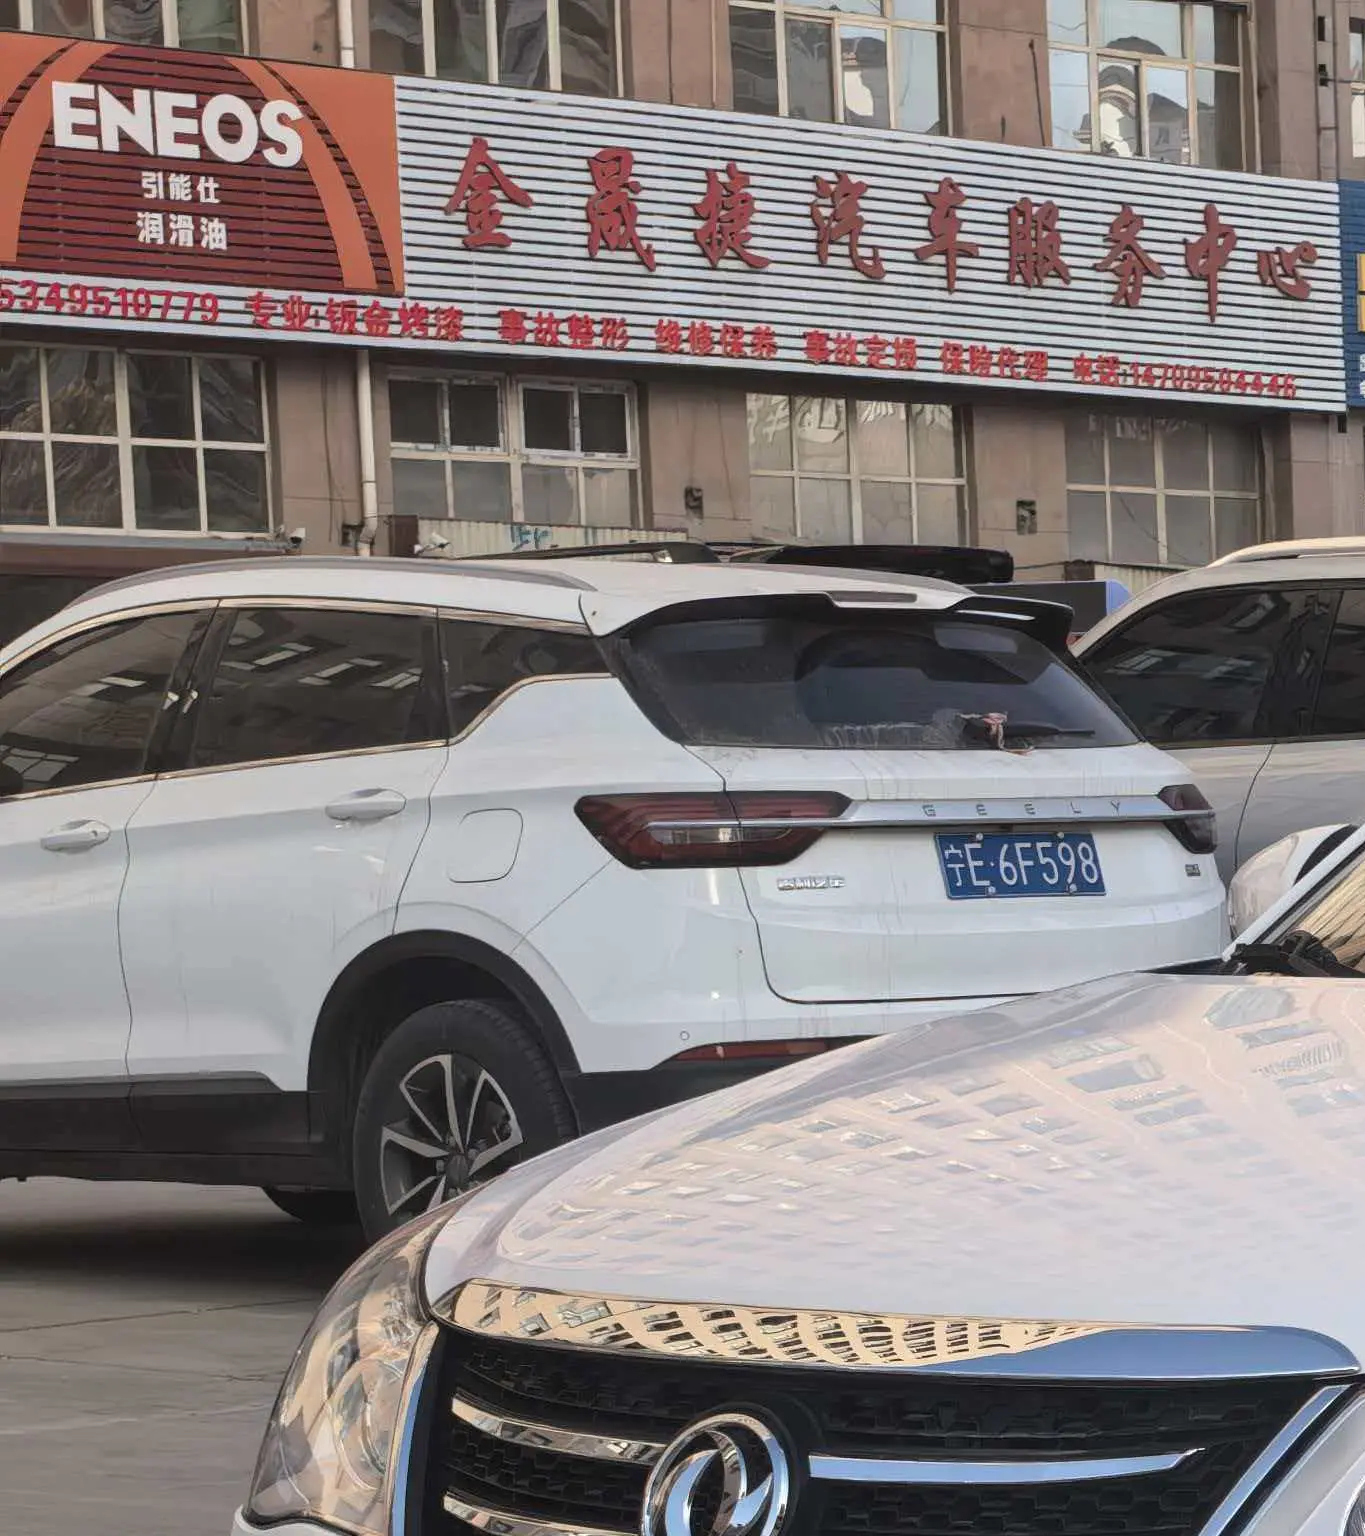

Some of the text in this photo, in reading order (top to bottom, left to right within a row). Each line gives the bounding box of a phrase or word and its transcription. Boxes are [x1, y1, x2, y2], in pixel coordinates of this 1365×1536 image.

[52, 81, 304, 168] ENEOS
[141, 171, 220, 204] 引能仕
[136, 211, 228, 250] 润滑油
[444, 136, 1318, 323] 金晟捷汽车服务中心
[498, 308, 630, 350] 事故整形
[655, 318, 777, 360] 维修保养
[801, 330, 918, 370] 事故定损
[940, 341, 1048, 382] 保险代理
[922, 800, 1120, 818] GEELY
